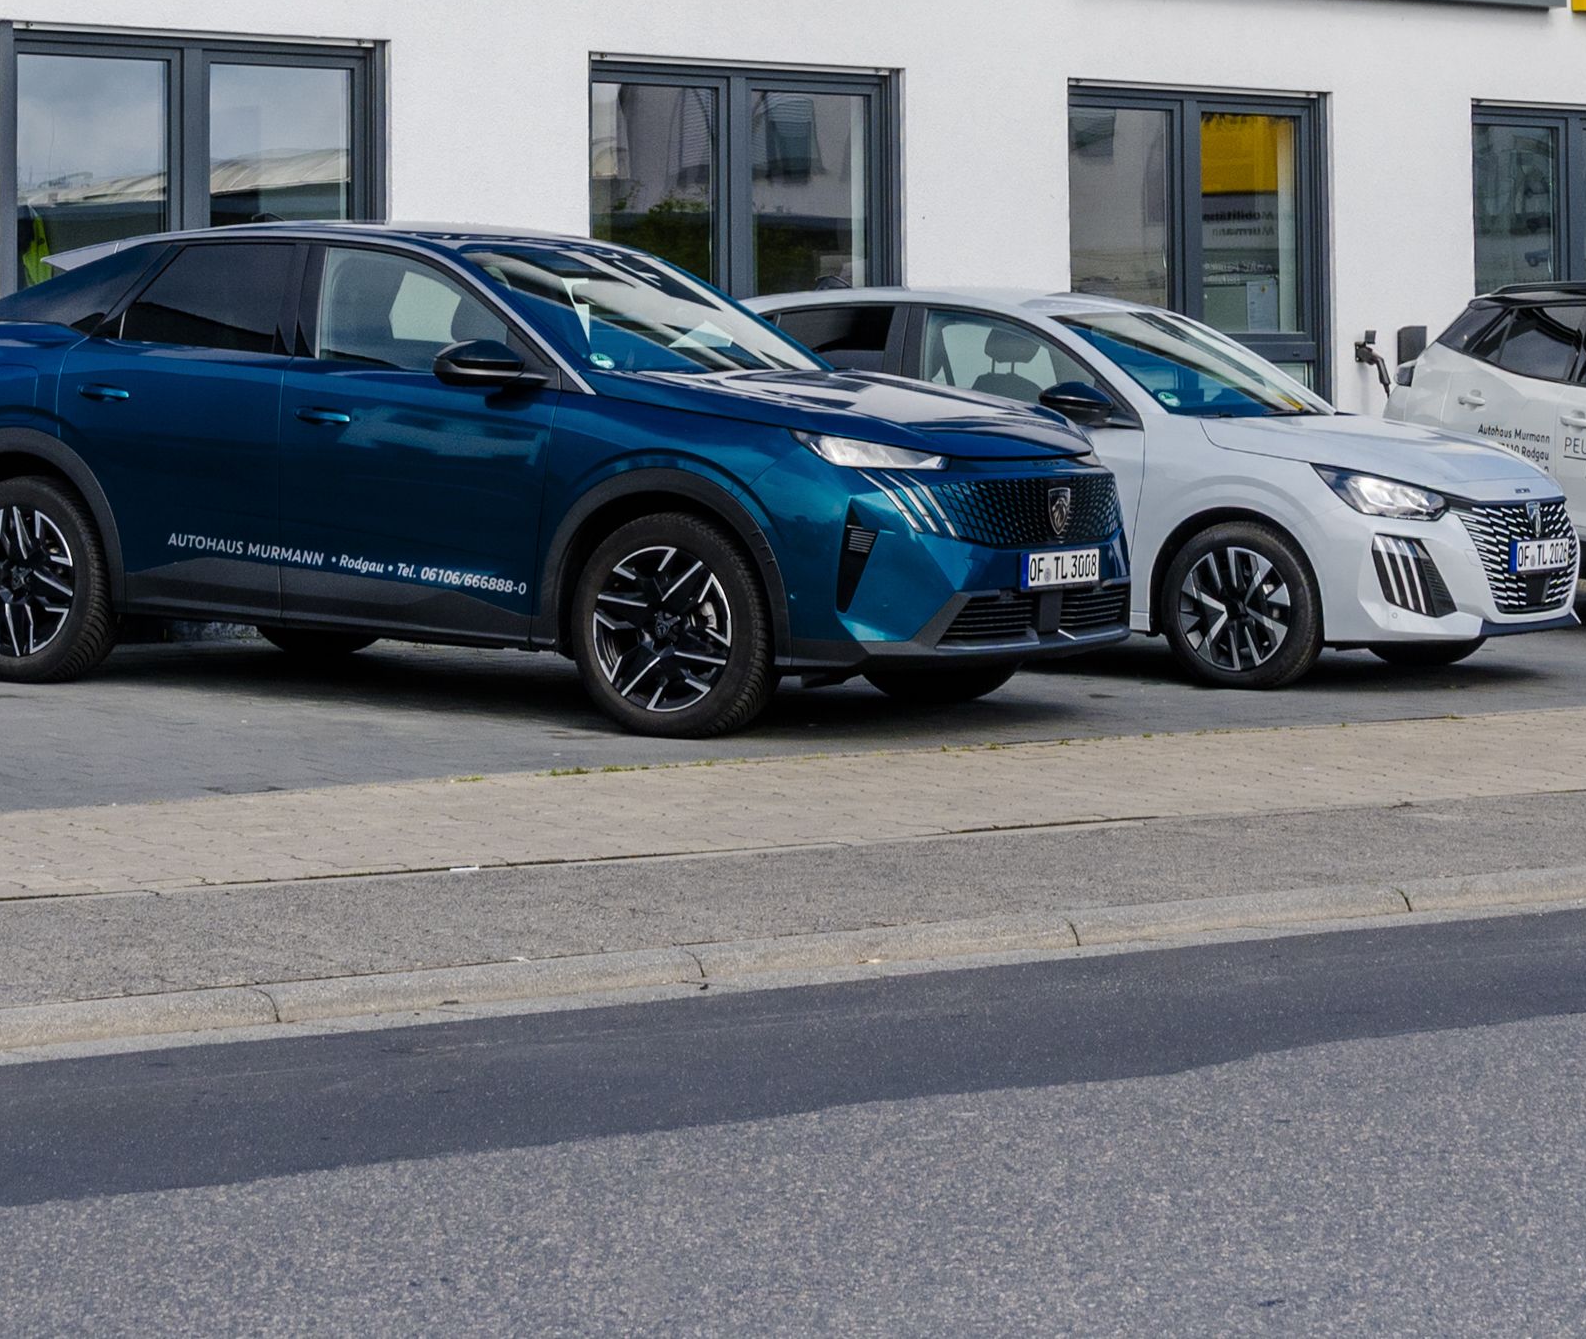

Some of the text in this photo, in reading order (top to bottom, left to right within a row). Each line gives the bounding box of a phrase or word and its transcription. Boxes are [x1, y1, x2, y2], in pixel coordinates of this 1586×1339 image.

[1478, 423, 1550, 444] Autohaus Murmann
[1521, 446, 1549, 462] Rodgau
[168, 532, 527, 595] AUTOHAUS MURMANN Rodgau Tel. 06106/666888-0
[1518, 545, 1530, 567] OF
[1537, 543, 1547, 565] TL
[1030, 554, 1097, 581] OF TL 3008
